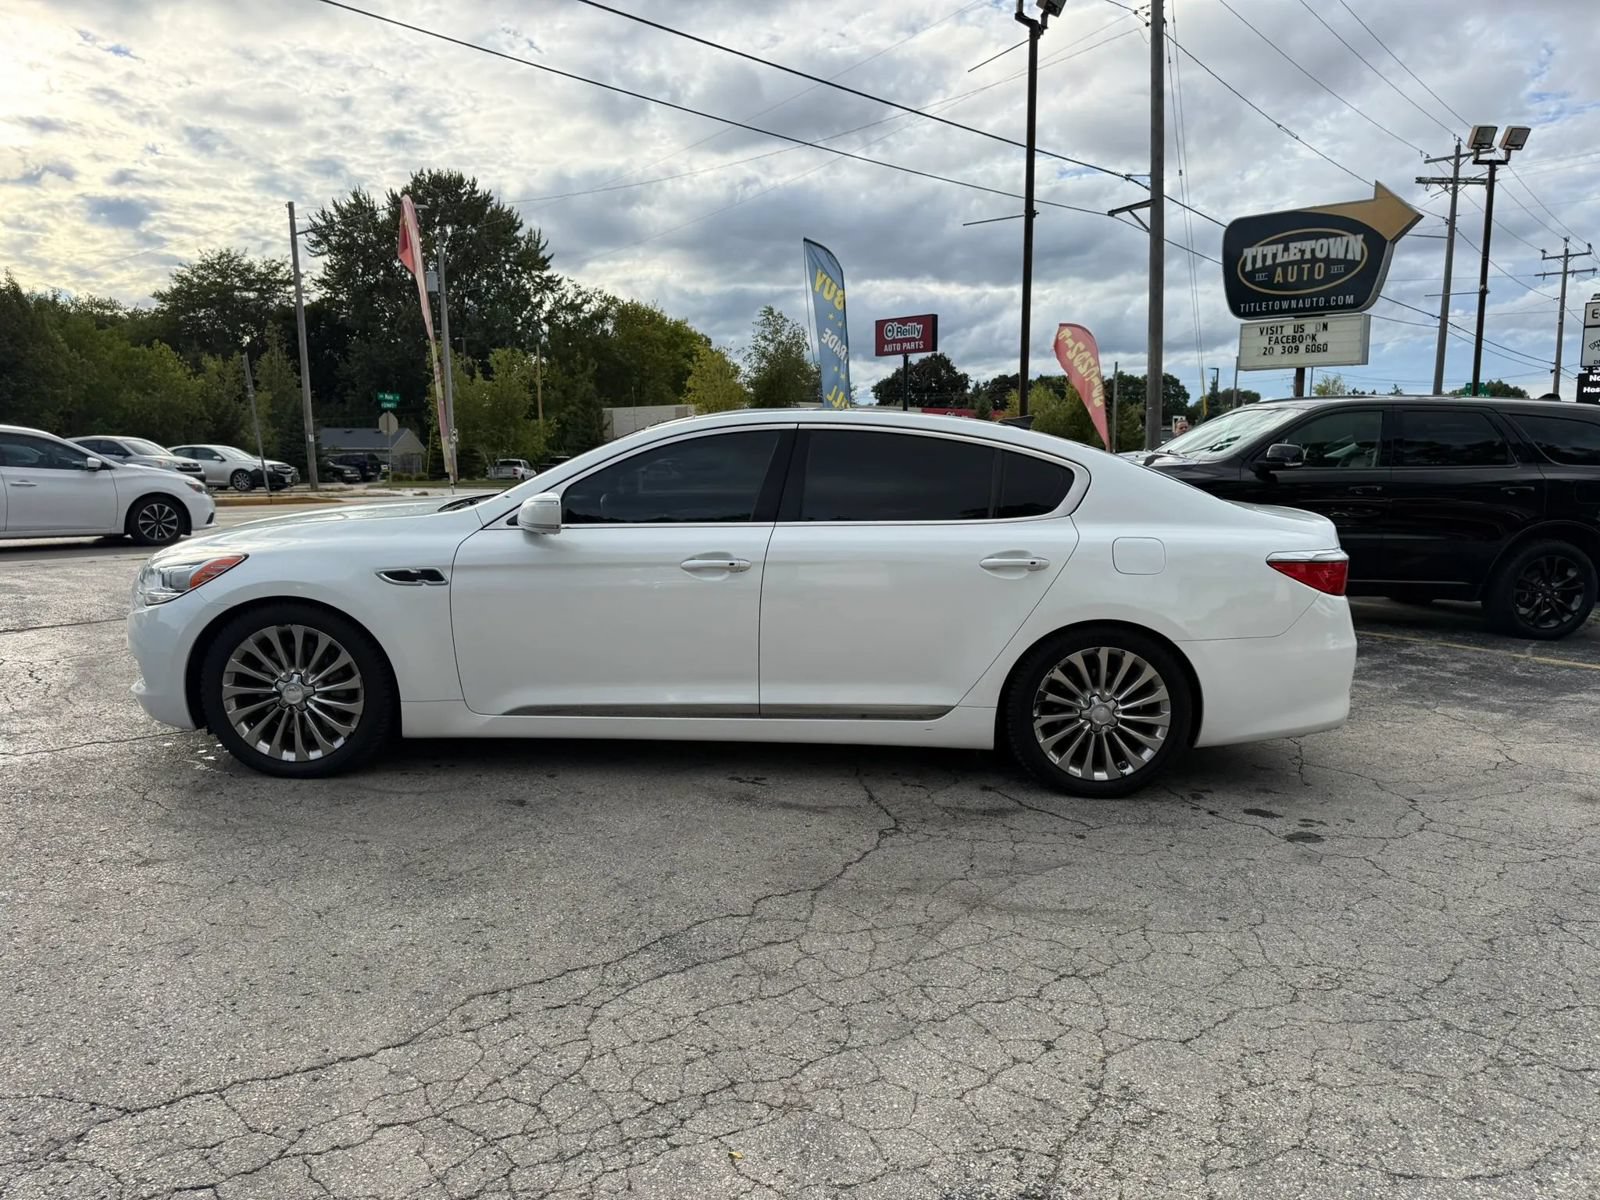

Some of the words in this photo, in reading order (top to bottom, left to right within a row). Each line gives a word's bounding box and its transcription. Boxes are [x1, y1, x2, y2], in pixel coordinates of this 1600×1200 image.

[1243, 234, 1364, 272] TITLETOWN
[1274, 262, 1325, 284] AUTO
[1240, 295, 1355, 313] TITLETOWNAUTO.COM
[884, 322, 923, 340] O'Reilly
[1259, 325, 1285, 336] VISIT
[1293, 324, 1305, 334] US
[884, 343, 901, 352] AUTO
[902, 341, 924, 350] PARTS
[1281, 345, 1300, 355] 309
[1305, 343, 1328, 353] 6060
